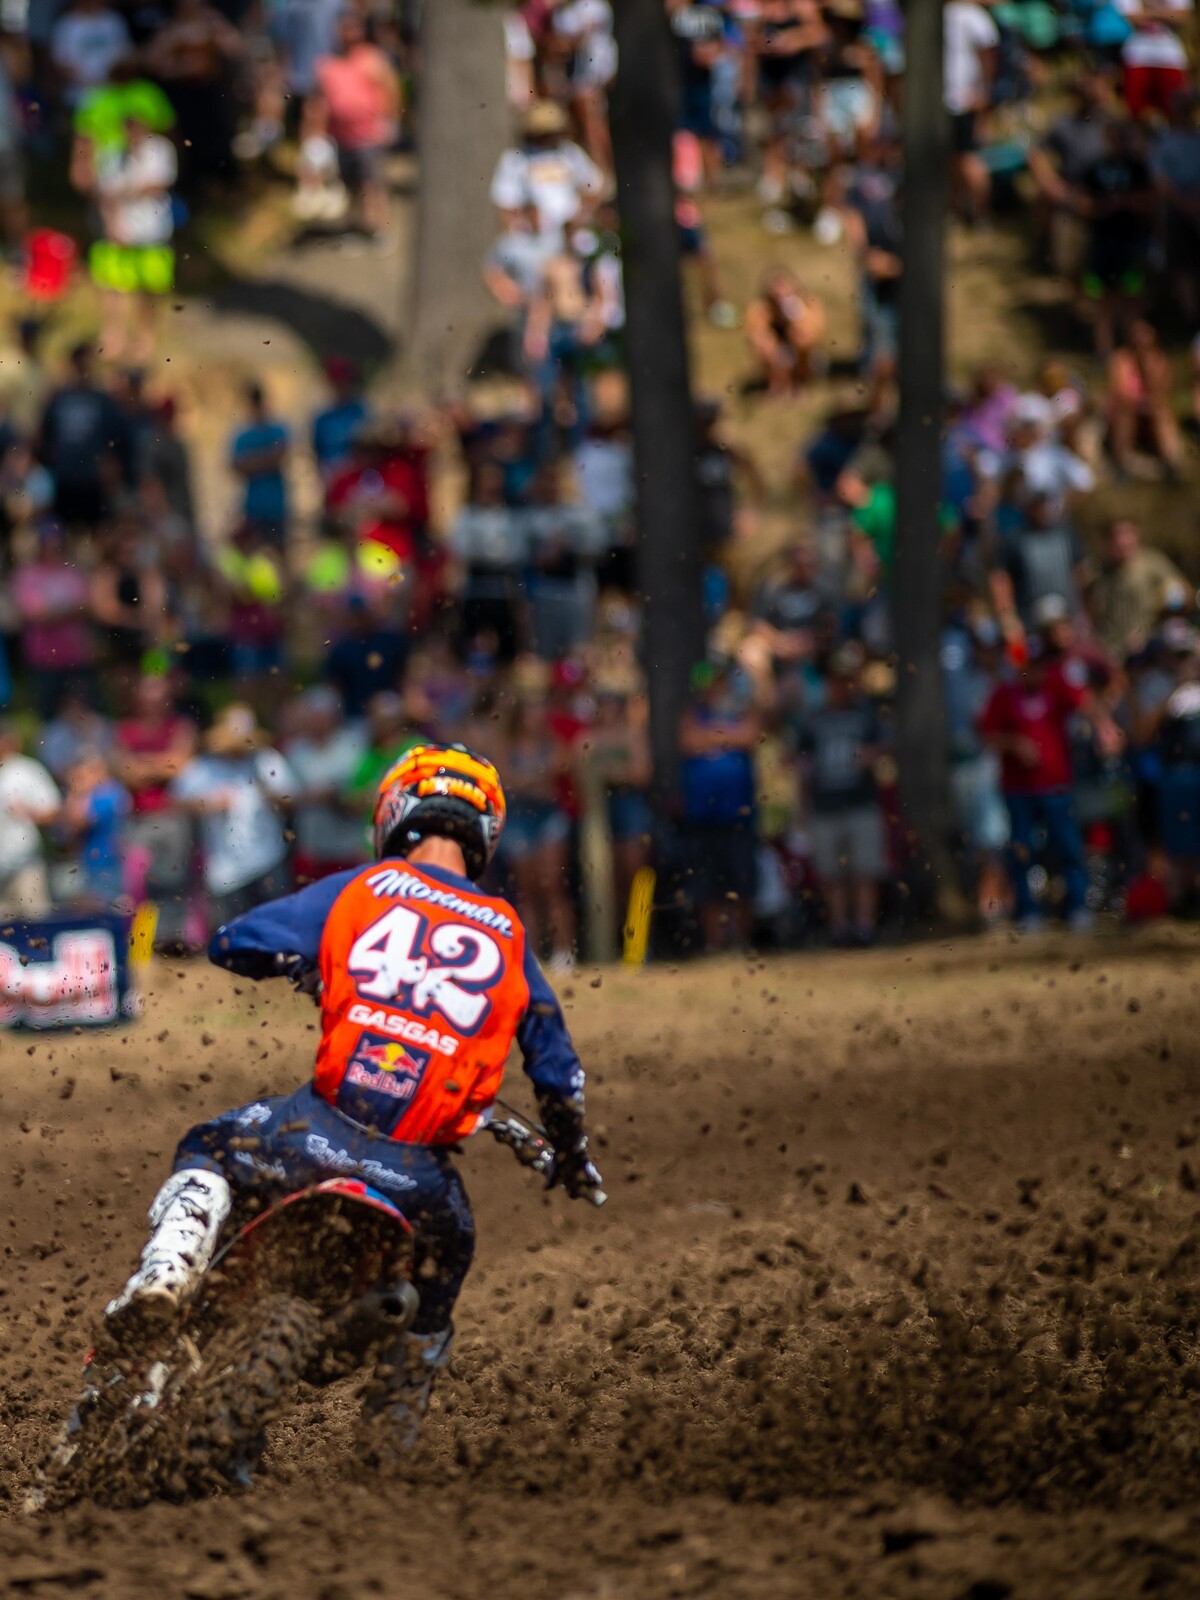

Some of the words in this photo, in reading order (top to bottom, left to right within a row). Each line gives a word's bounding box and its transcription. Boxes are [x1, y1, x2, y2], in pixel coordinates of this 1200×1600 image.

[366, 869, 514, 939] Mosman
[348, 904, 501, 1029] 42
[347, 1003, 460, 1057] GASGAS
[346, 1060, 383, 1092] Red
[379, 1069, 417, 1100] Bull
